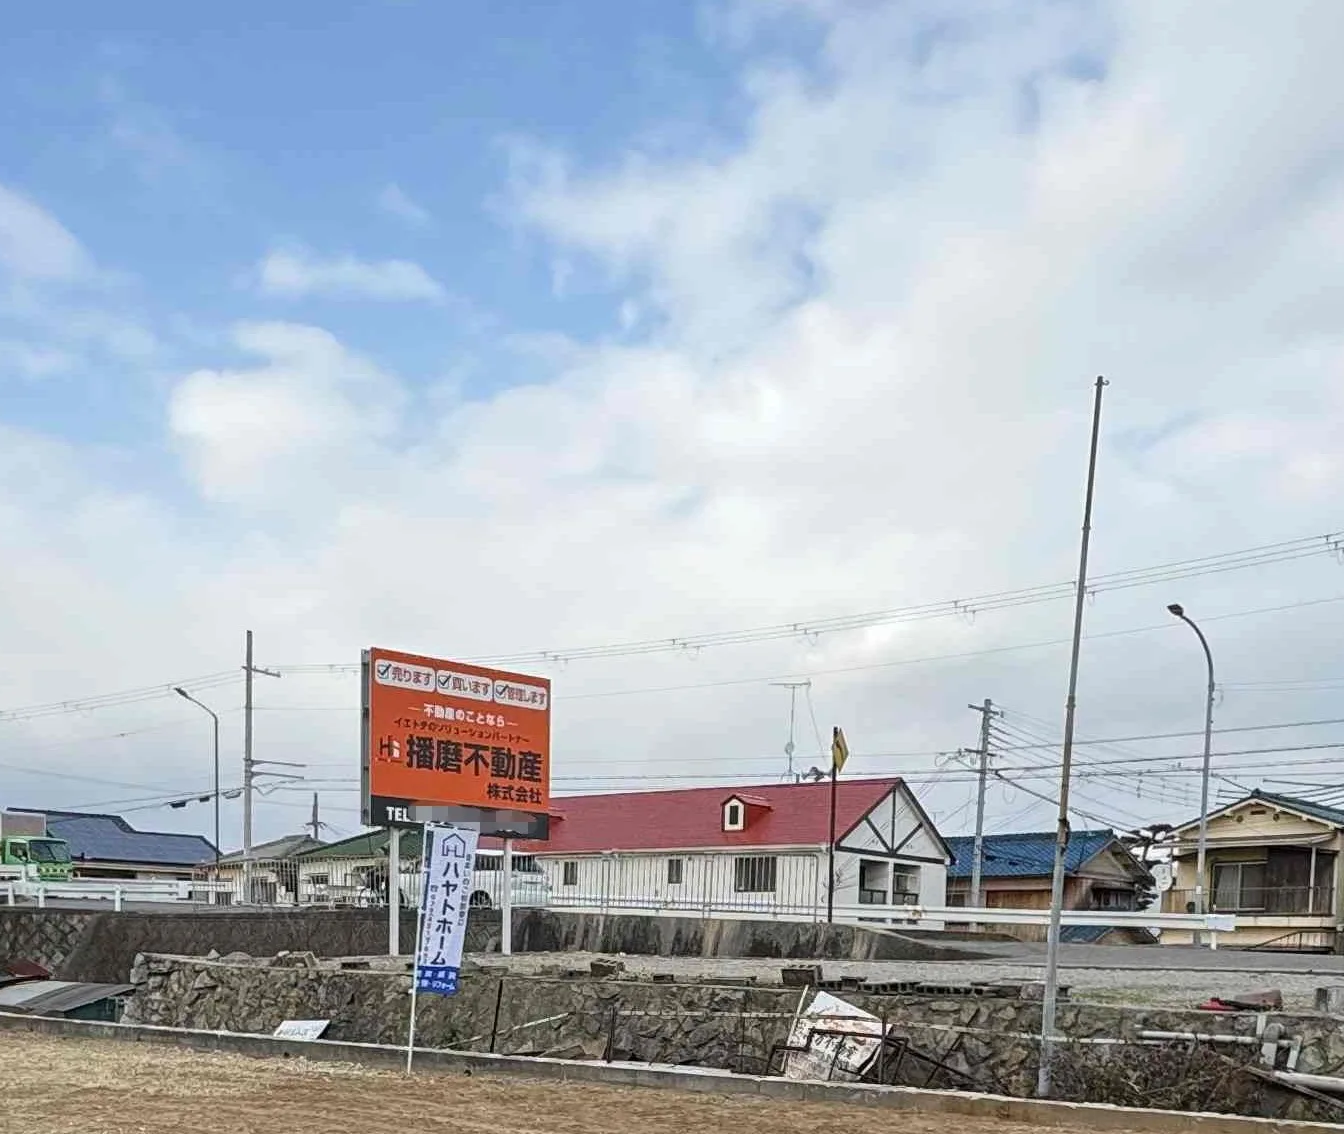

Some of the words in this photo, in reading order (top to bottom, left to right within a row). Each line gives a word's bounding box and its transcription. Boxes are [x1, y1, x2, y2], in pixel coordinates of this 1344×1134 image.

[392, 665, 433, 687] 売ります
[451, 675, 491, 697] 買います
[423, 702, 505, 728] 不動産のことなら
[406, 733, 543, 783] 播磨不動産
[487, 782, 543, 805] 株式会社
[386, 806, 408, 821] TEL
[430, 861, 460, 966] ハヤトホーム
